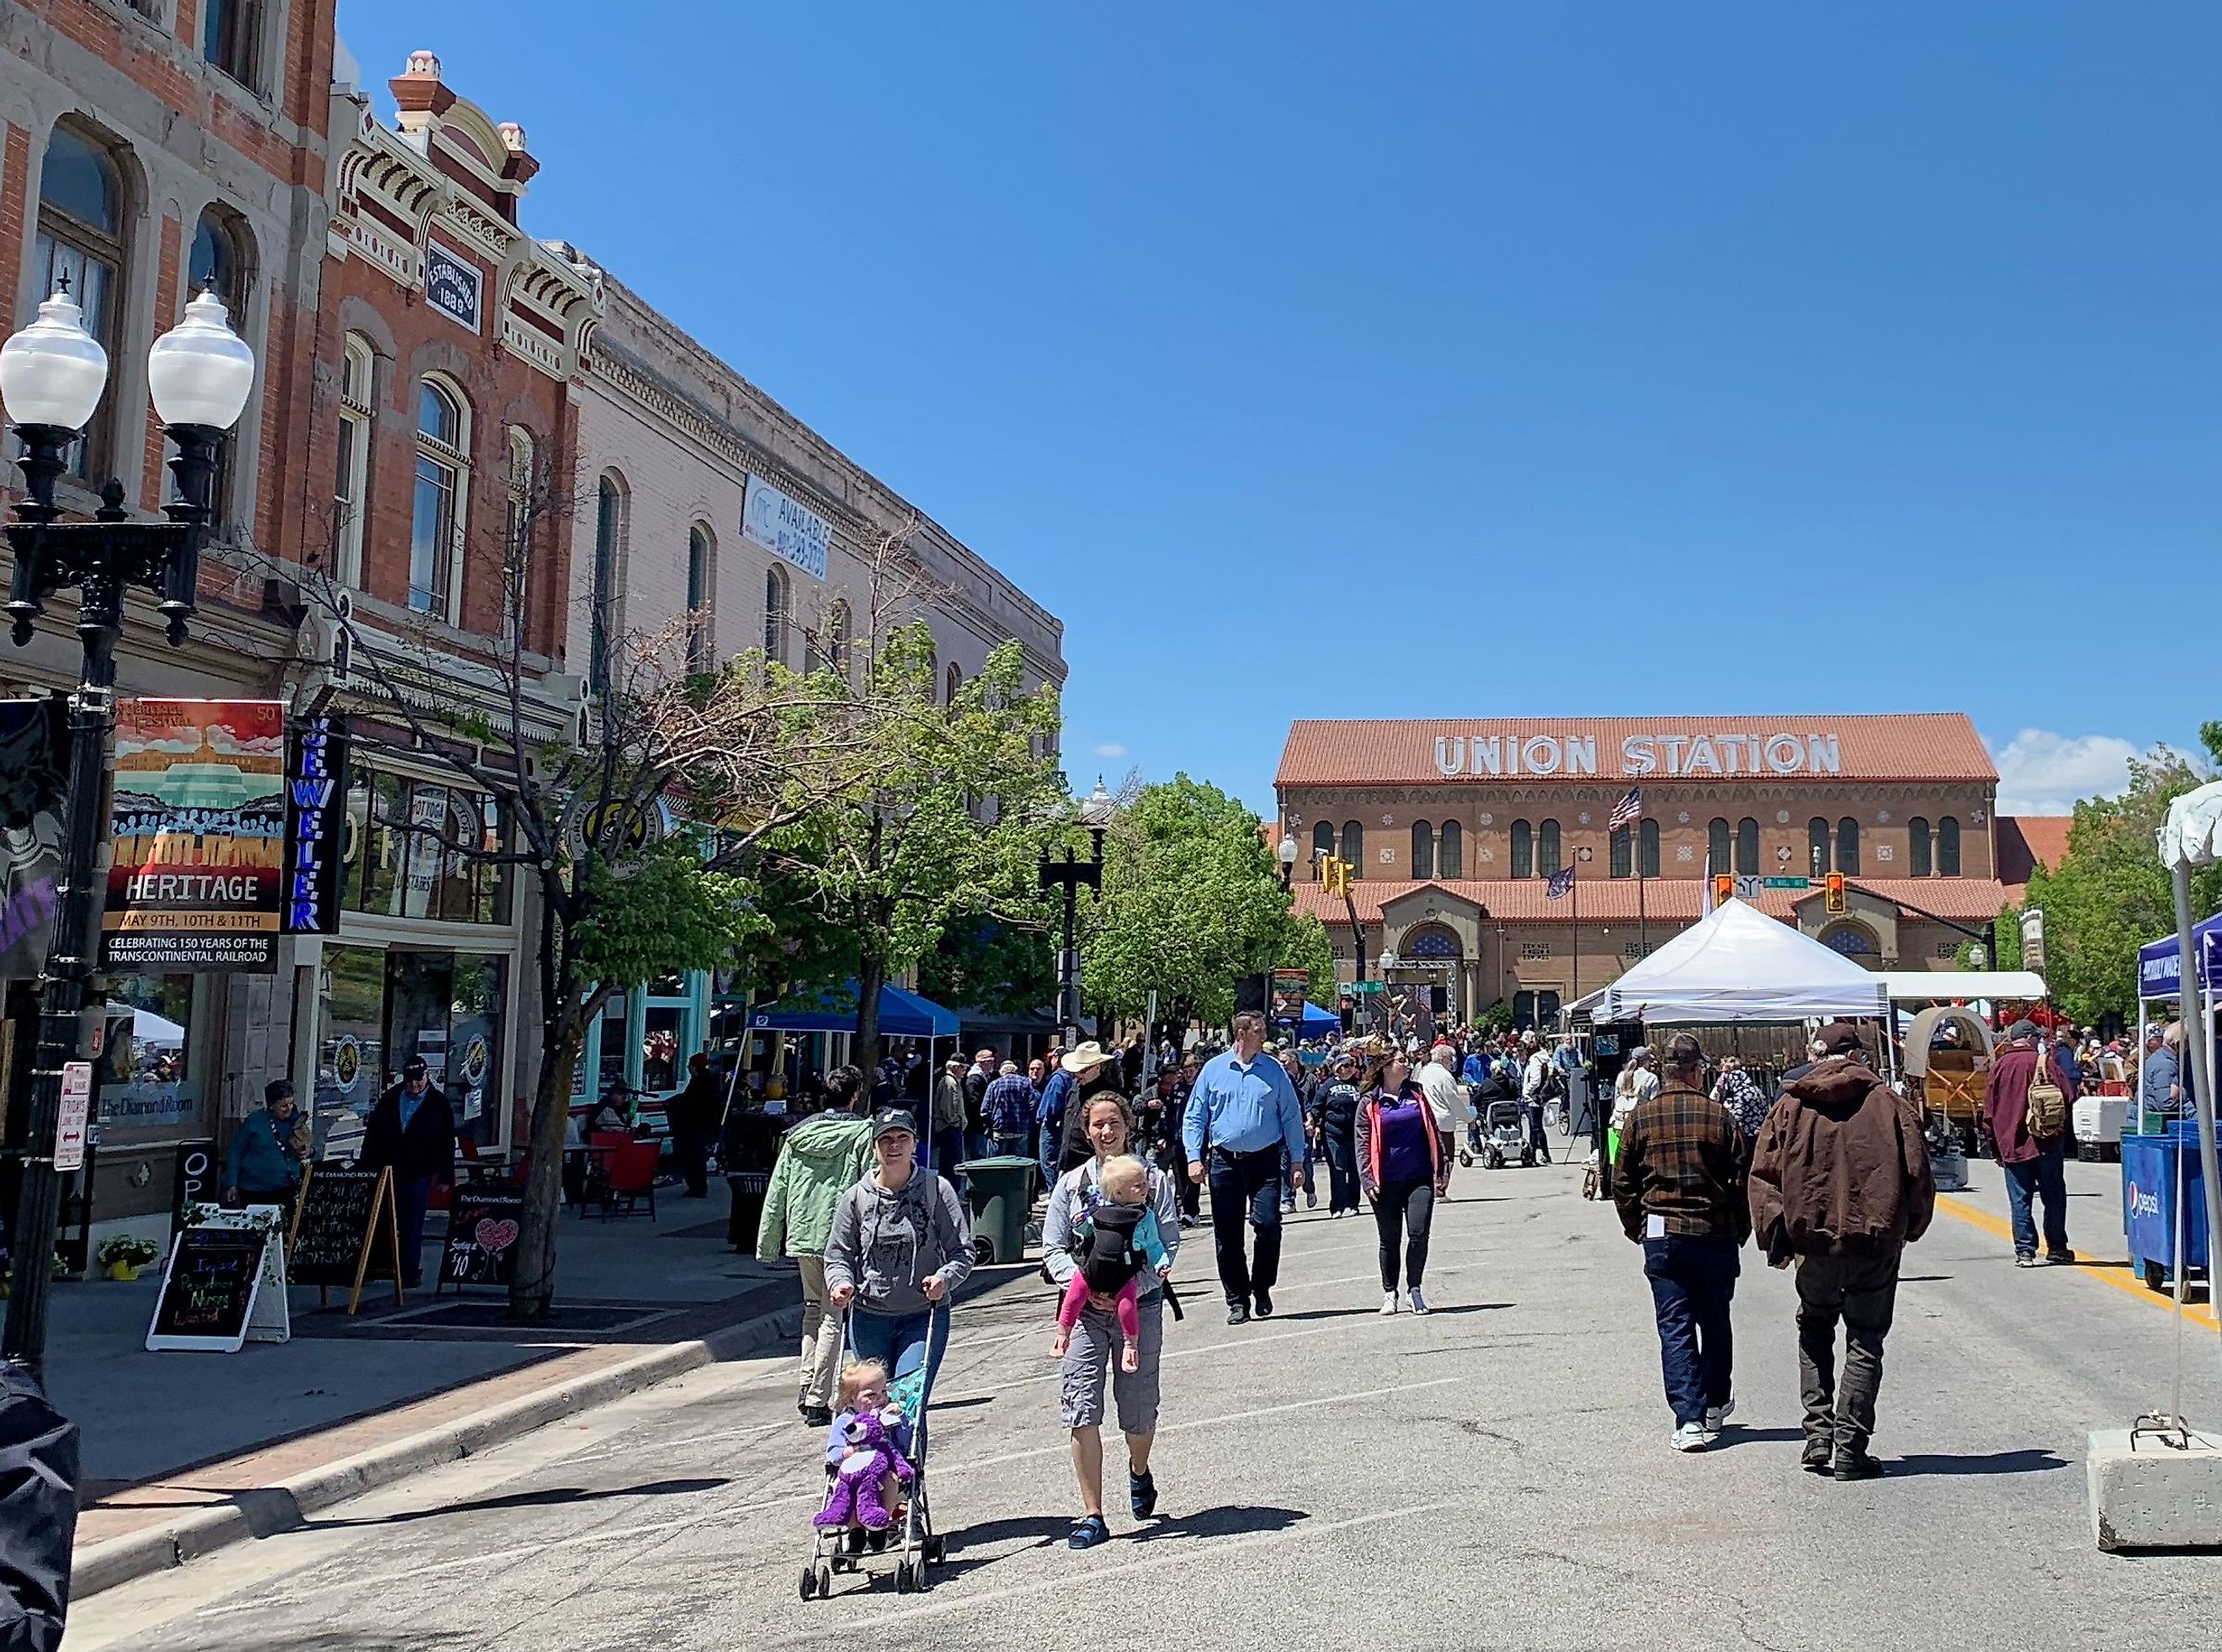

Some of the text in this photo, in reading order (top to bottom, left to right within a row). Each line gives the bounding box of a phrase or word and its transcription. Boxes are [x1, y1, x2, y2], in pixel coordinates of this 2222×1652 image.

[428, 263, 474, 311] ESTABLISHED
[440, 287, 464, 314] 1889
[779, 498, 832, 547] AVAILABLE
[1436, 733, 1841, 775] UNION STATION
[290, 718, 335, 930] JEWELER
[127, 875, 258, 901] HERITAGE
[121, 915, 260, 927] MAY 9TH, 10TH & 11TH
[109, 938, 268, 949] CELEBRATING 150 YEARS OF THE
[109, 951, 267, 963] TRANSCONTINENTAL RAILROAD
[120, 1097, 164, 1116] Diamond
[163, 1095, 193, 1112] Room
[2139, 1193, 2159, 1217] pepsi
[452, 1252, 469, 1277] $10
